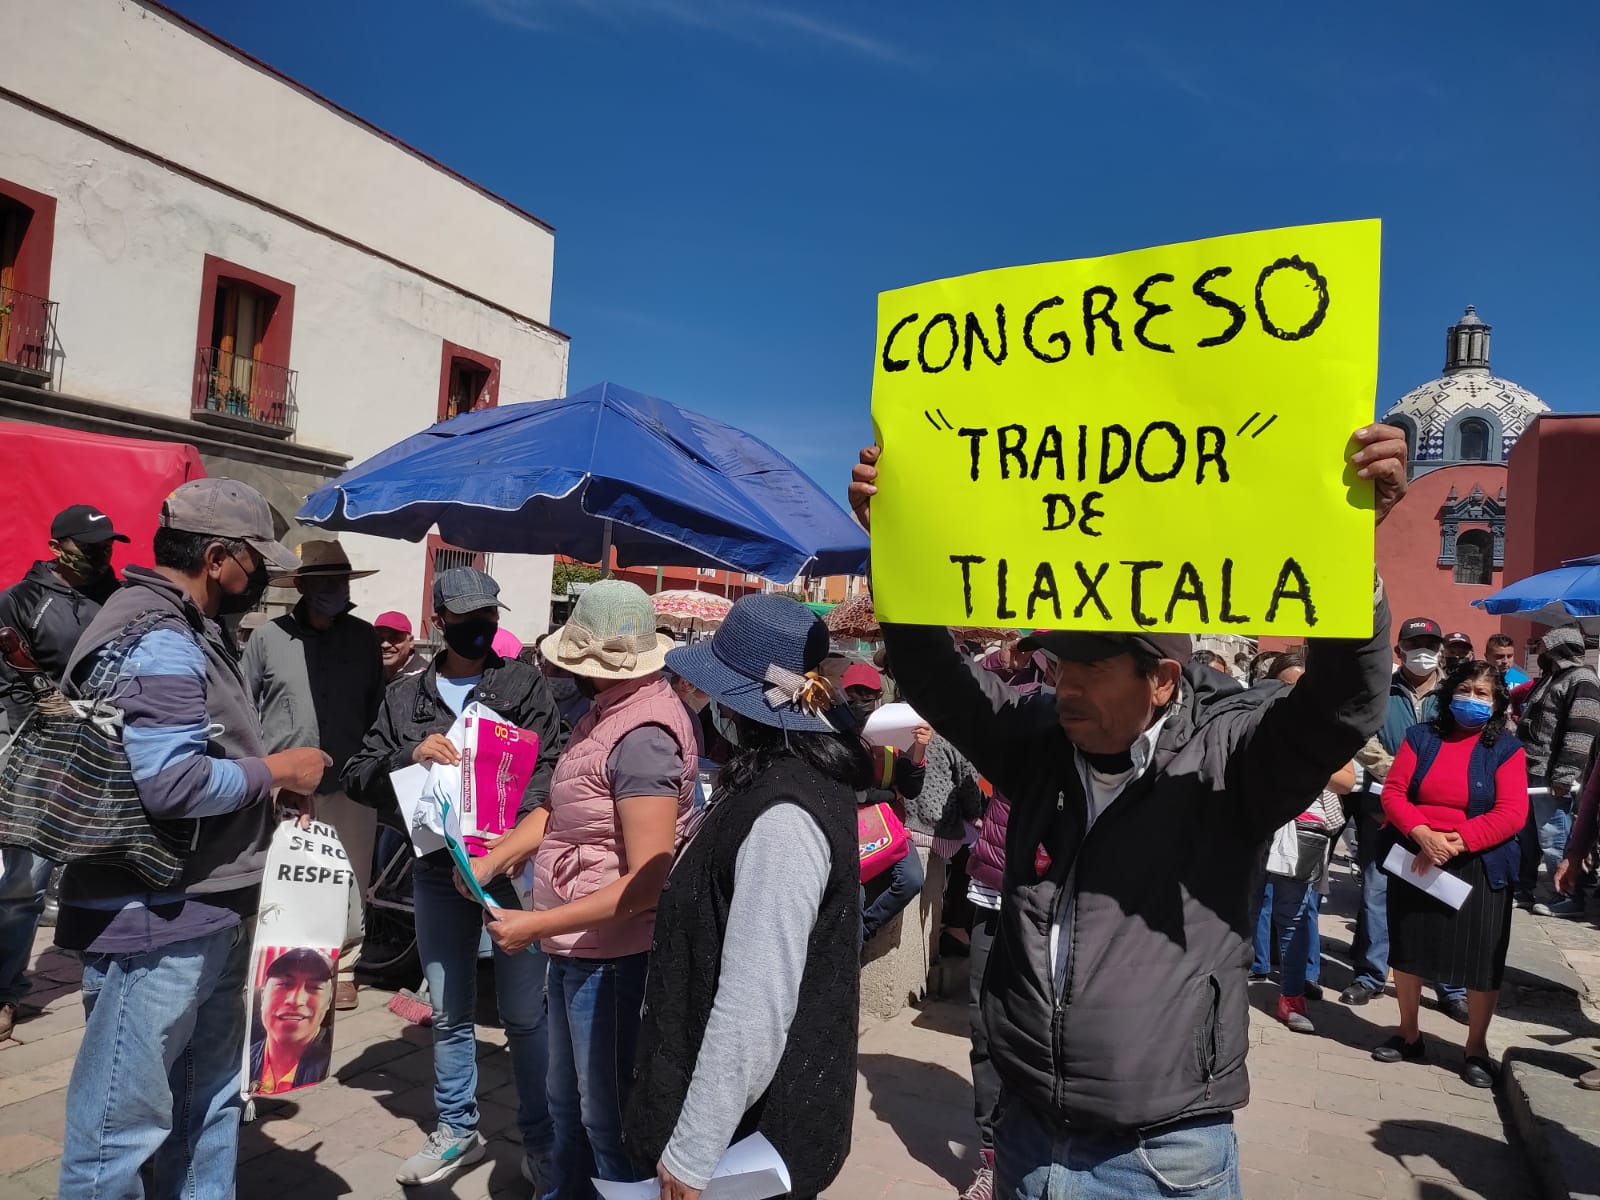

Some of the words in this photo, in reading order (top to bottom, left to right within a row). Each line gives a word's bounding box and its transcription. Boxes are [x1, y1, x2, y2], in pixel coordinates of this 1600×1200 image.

[882, 254, 1330, 372] CONGRESO
[1043, 491, 1105, 537] DE
[949, 556, 1318, 627] TLAXTALA
[289, 836, 314, 852] SE
